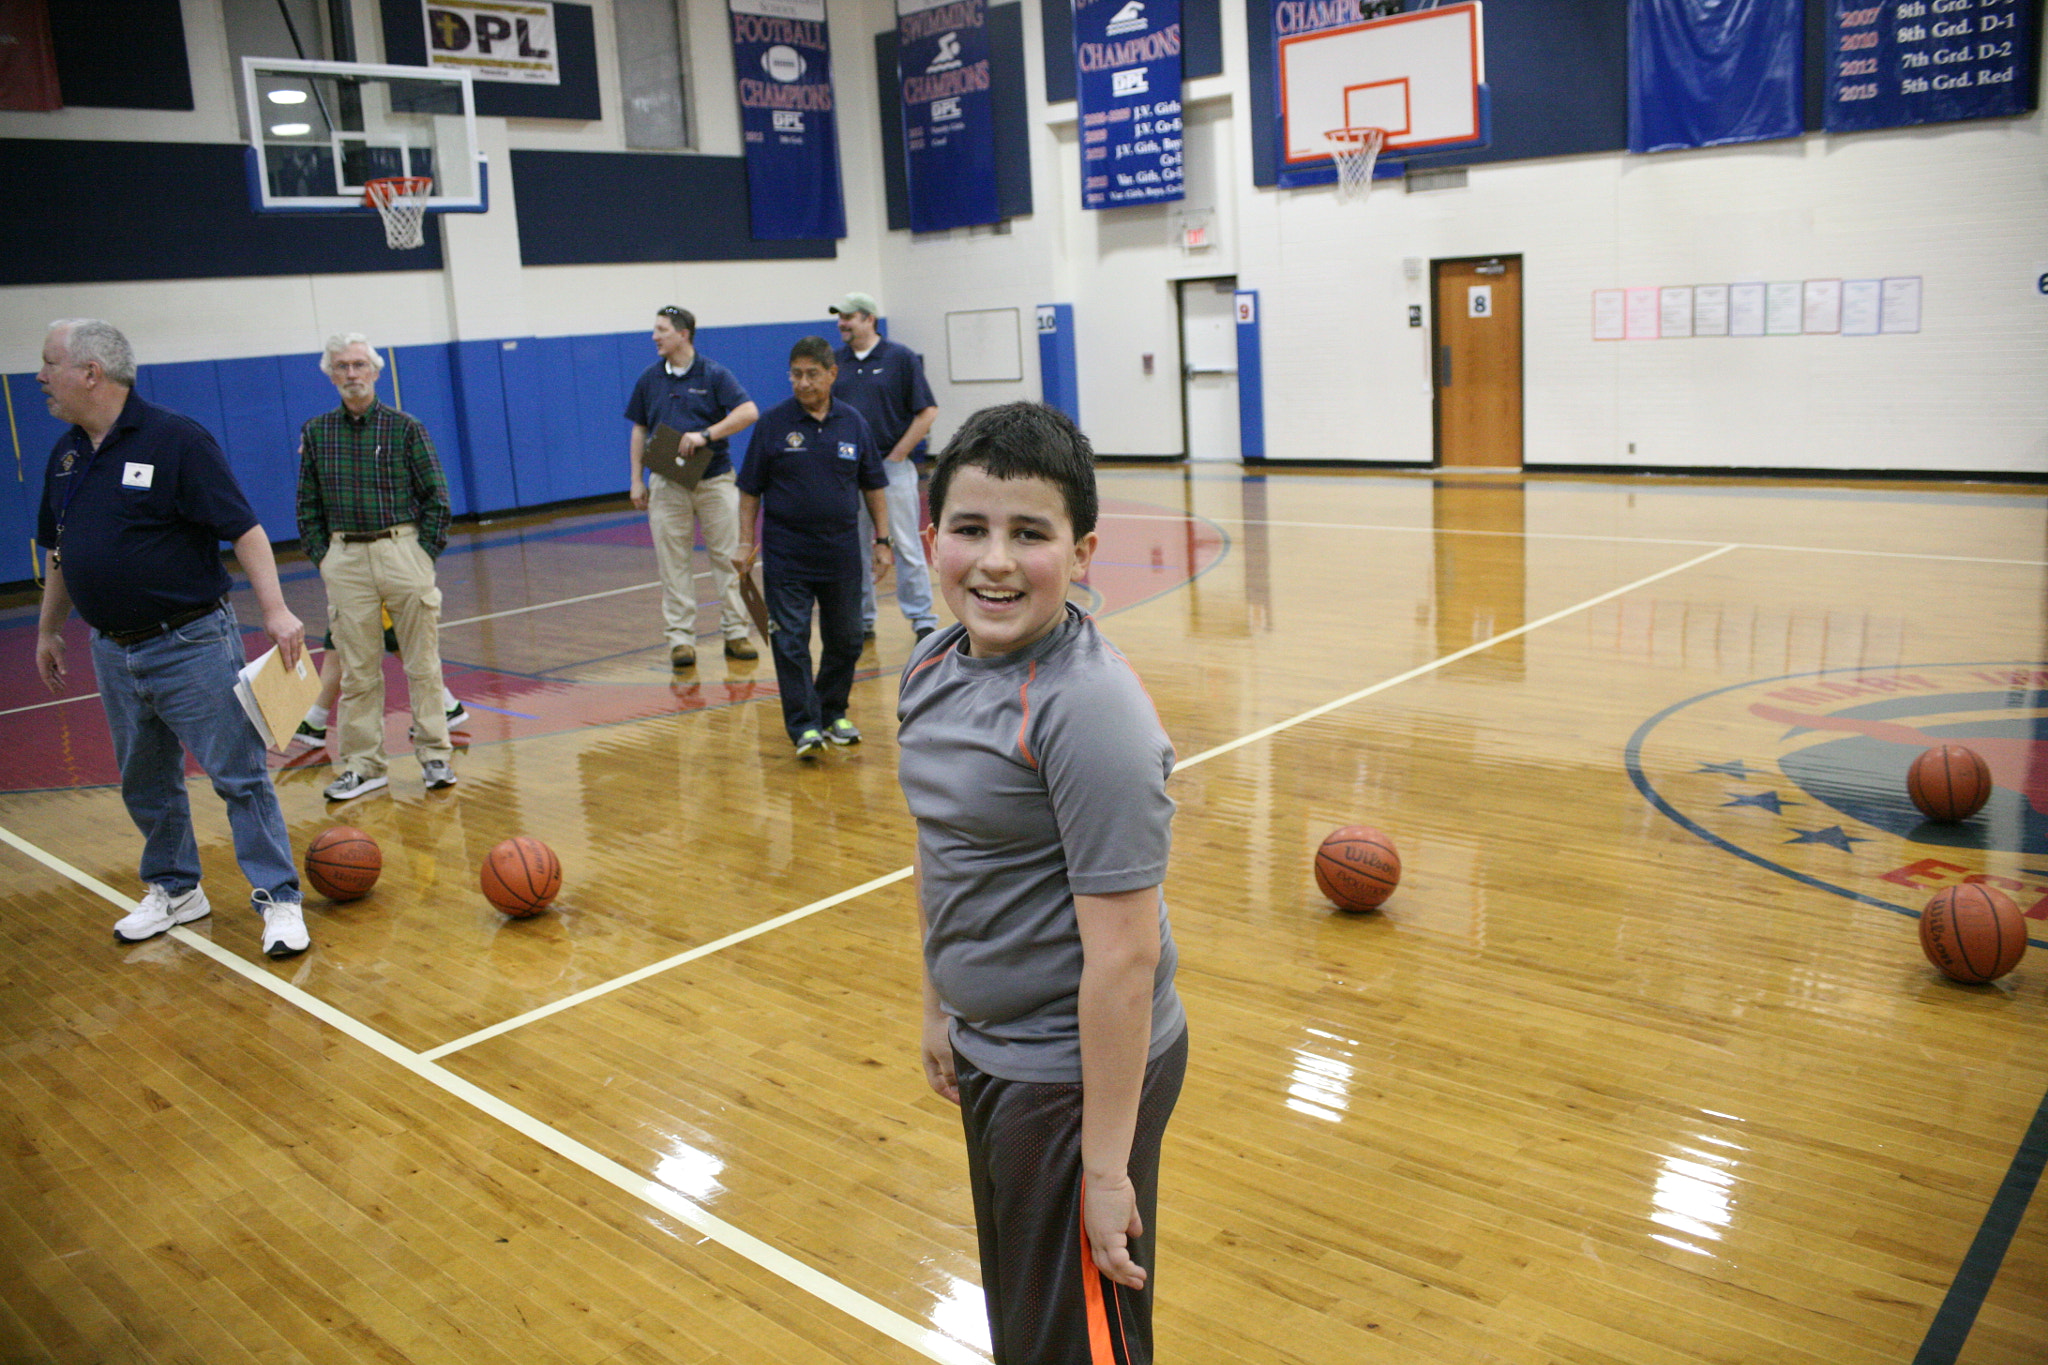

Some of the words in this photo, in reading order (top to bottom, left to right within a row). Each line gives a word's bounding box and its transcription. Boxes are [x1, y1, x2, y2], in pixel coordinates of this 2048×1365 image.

[734, 13, 827, 51] FOOTBALL
[901, 1, 985, 44] SWIMMING
[1840, 8, 1880, 28] 2007
[1896, 0, 1926, 19] 8th
[1896, 25, 1926, 43] 8th
[1931, 19, 1973, 38] Grd.
[1980, 12, 2015, 32] D-1
[428, 10, 549, 58] DPL
[1080, 23, 1181, 72] CHAMPIONS
[1839, 58, 1878, 77] 2012
[1901, 51, 1929, 69] 7th
[1932, 46, 1974, 65] Grd.
[1978, 41, 2012, 60] D-2
[740, 78, 833, 111] CHAMPIONS
[904, 59, 990, 105] CHAMPIONS
[1838, 83, 1878, 102] 2015
[1901, 77, 1929, 95] 5th
[1932, 72, 1973, 91] Grd.
[1976, 66, 2014, 86] Red
[1240, 304, 1249, 319] 9
[1474, 295, 1486, 312] 8
[1038, 315, 1055, 330] 10
[1930, 899, 1953, 965] Wilson
